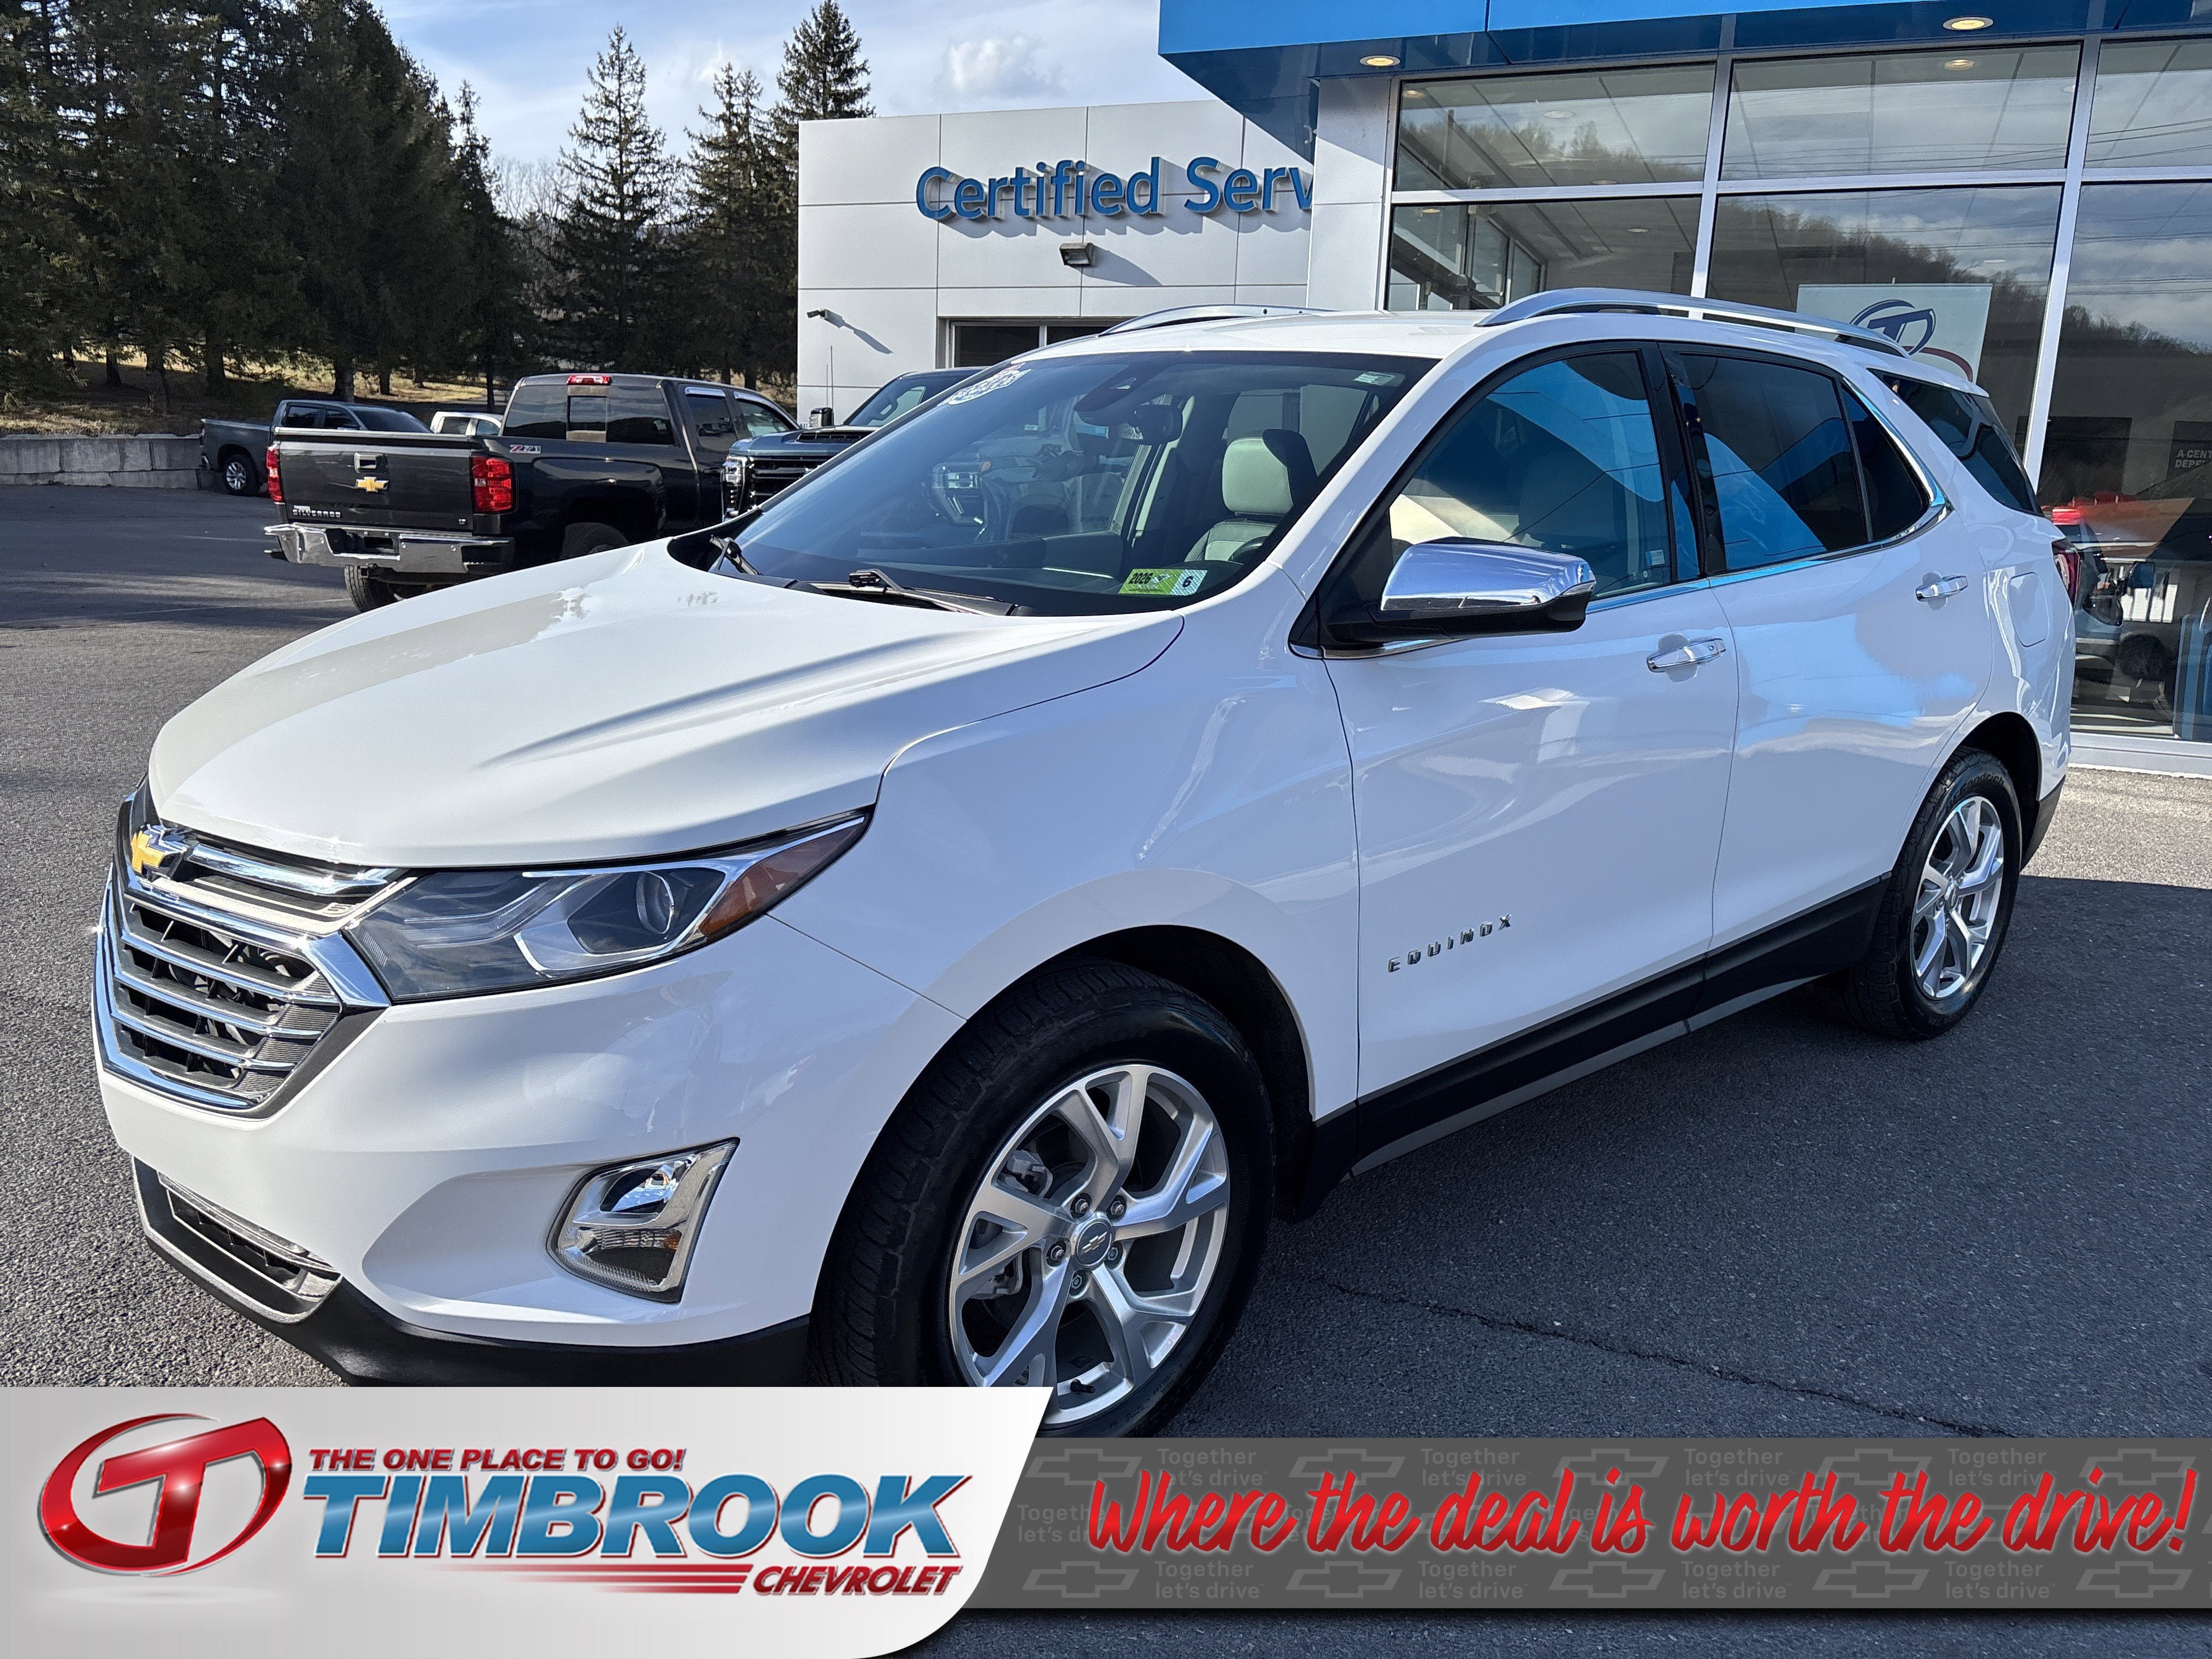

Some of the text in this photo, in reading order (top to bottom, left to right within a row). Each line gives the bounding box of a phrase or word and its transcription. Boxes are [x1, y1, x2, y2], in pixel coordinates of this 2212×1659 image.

[916, 156, 1313, 219] Certified Serv
[1128, 572, 1194, 588] 2026 6
[1387, 913, 1513, 973] EQUINOX
